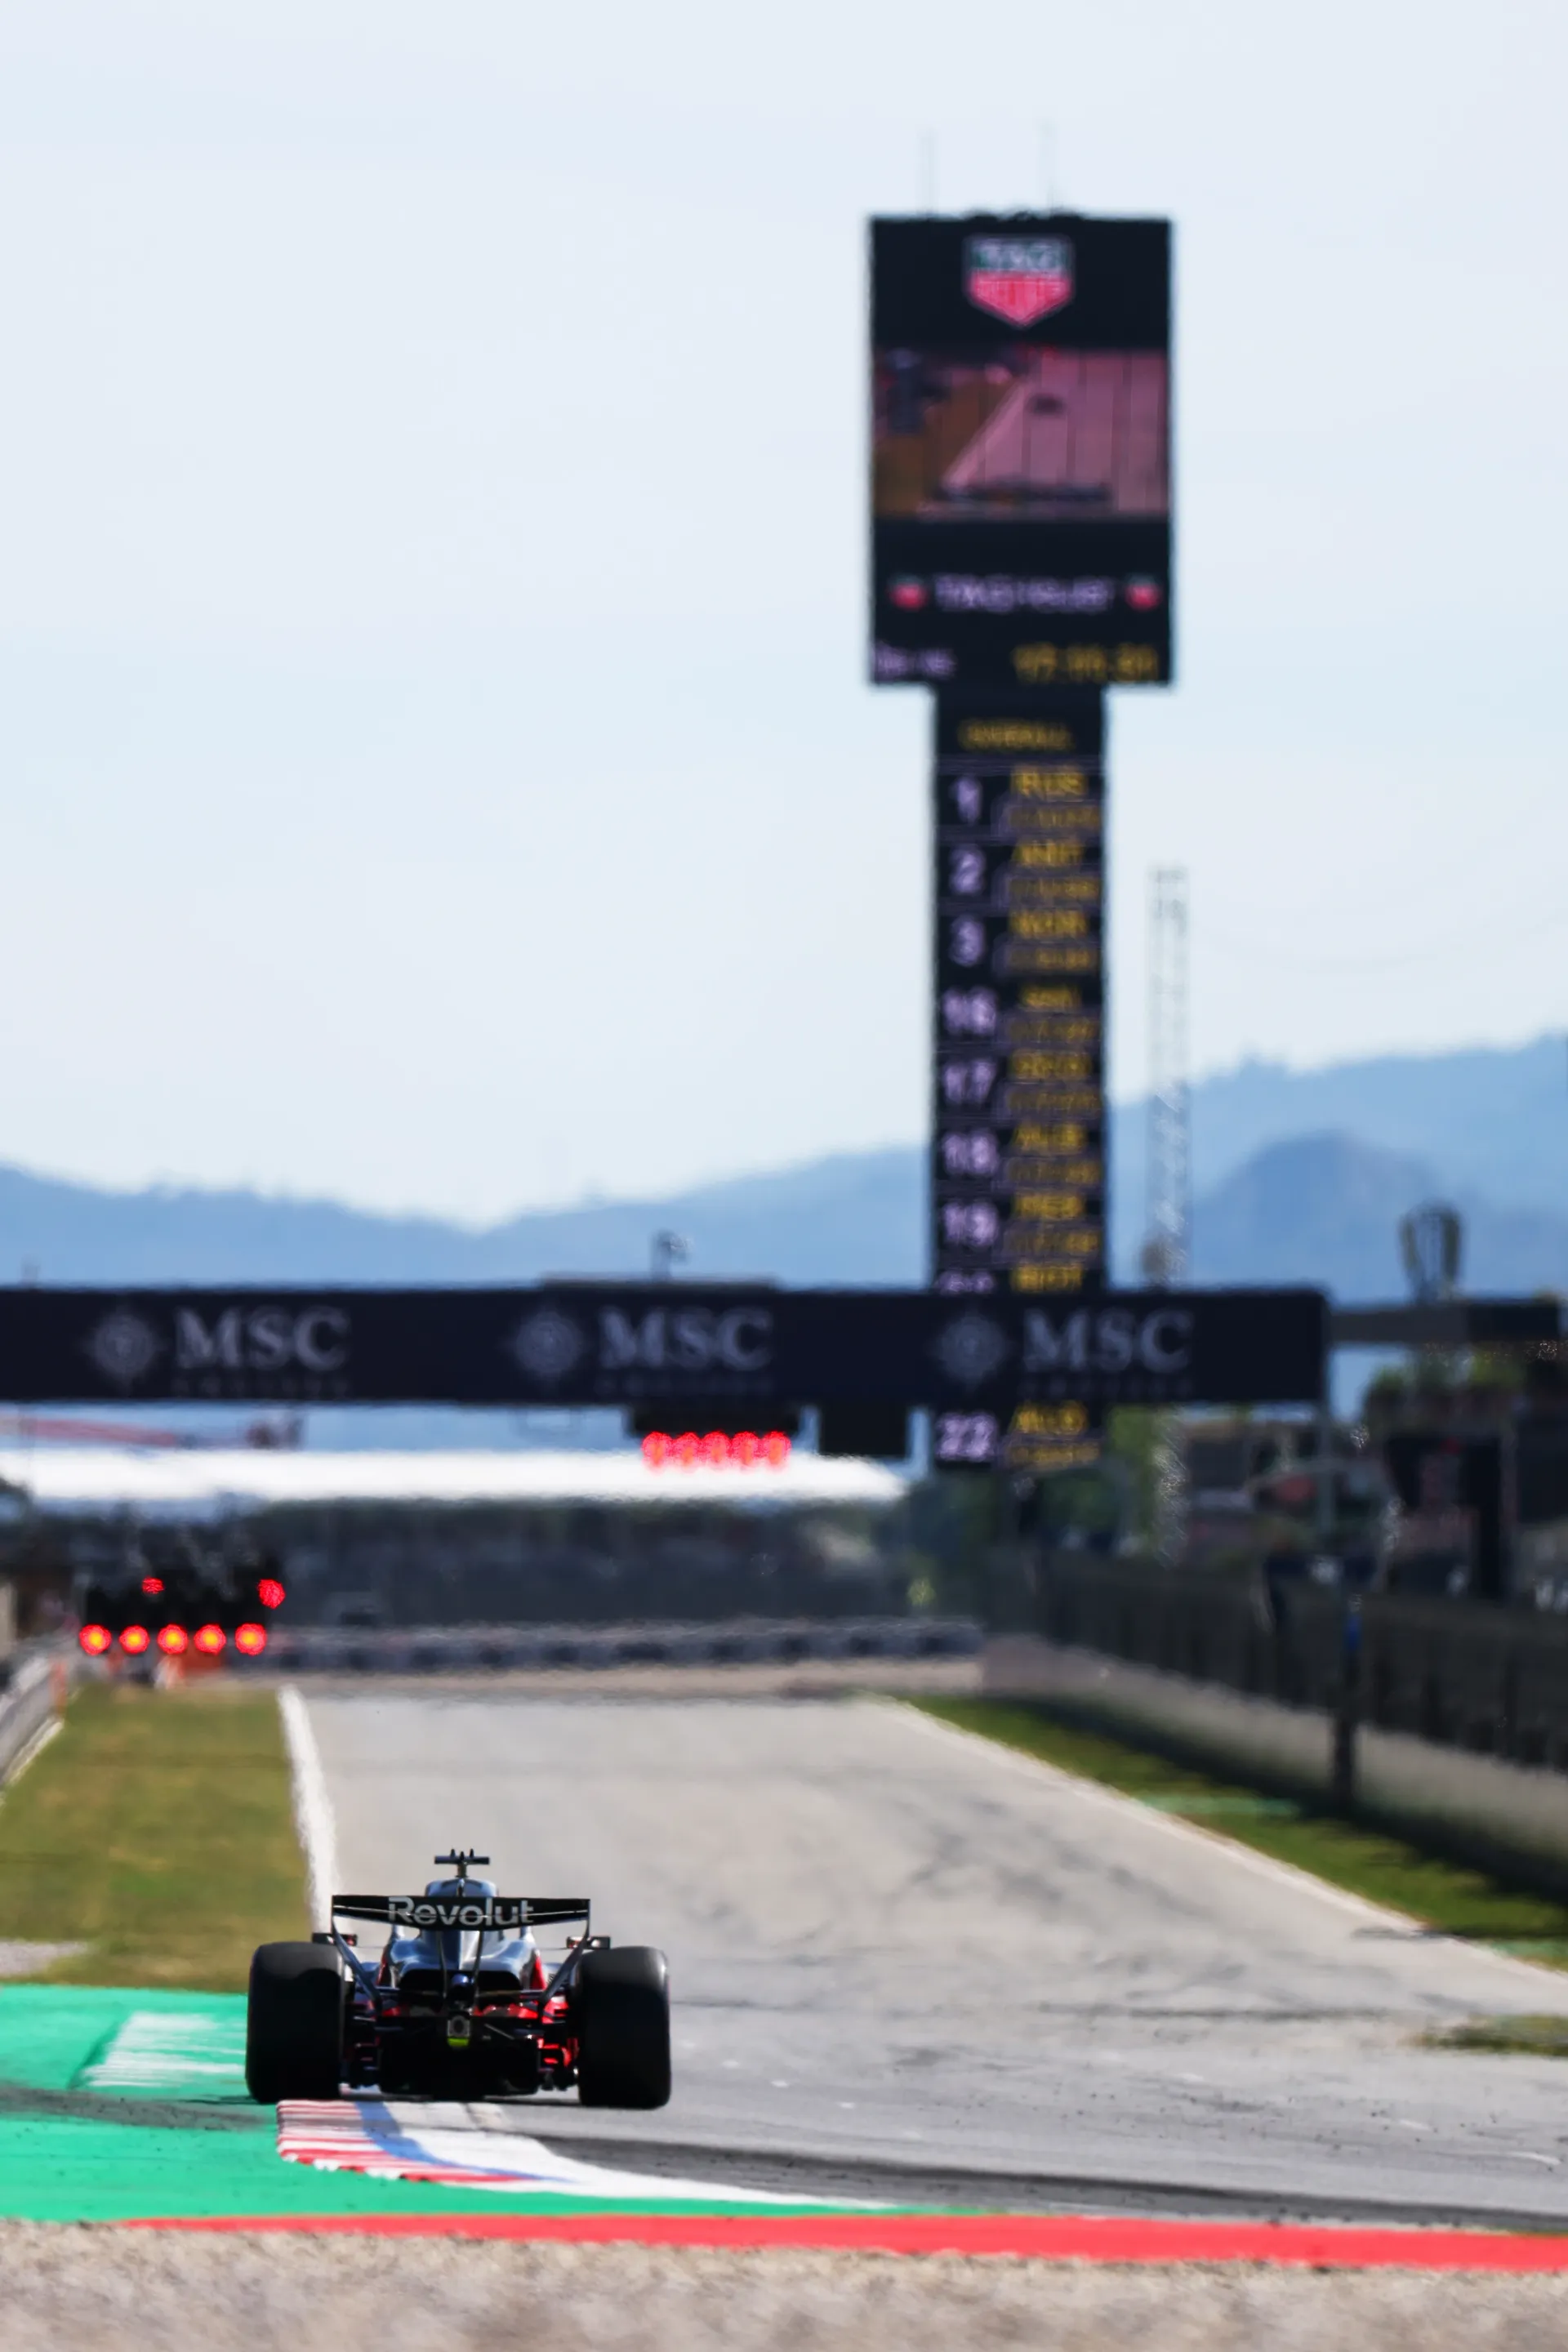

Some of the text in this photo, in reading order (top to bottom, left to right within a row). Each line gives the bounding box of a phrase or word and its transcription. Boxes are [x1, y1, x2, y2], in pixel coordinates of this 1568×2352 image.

[951, 774, 982, 824] 1
[950, 844, 985, 896] 2
[949, 915, 985, 967] 3
[942, 1059, 996, 1104] 17
[174, 1307, 349, 1370] MSC
[599, 1307, 773, 1371] MSC
[1022, 1308, 1193, 1373] MSC
[937, 1412, 998, 1461] 22
[388, 1896, 535, 1927] Revolut
